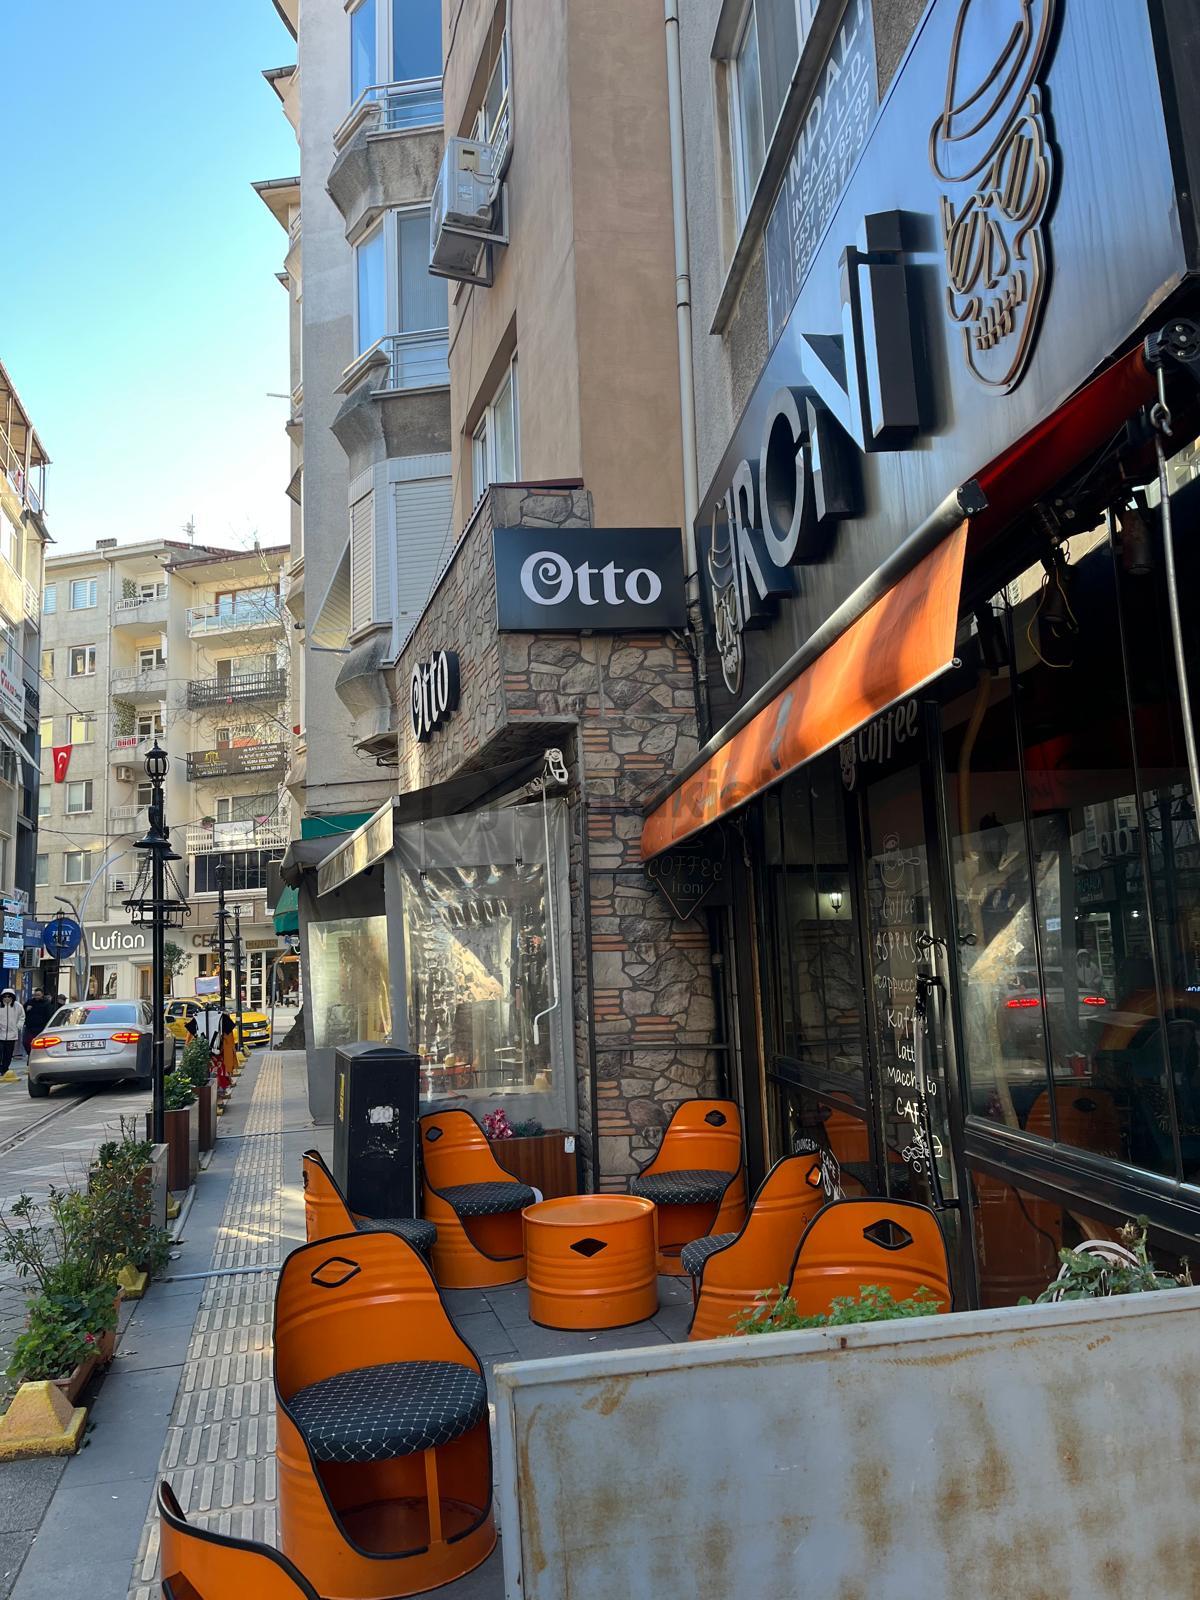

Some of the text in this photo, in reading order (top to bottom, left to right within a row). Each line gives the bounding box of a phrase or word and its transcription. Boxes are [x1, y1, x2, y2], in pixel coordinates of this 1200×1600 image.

[520, 551, 662, 606] Otto
[411, 649, 454, 743] Otto
[91, 930, 145, 950] Lufian
